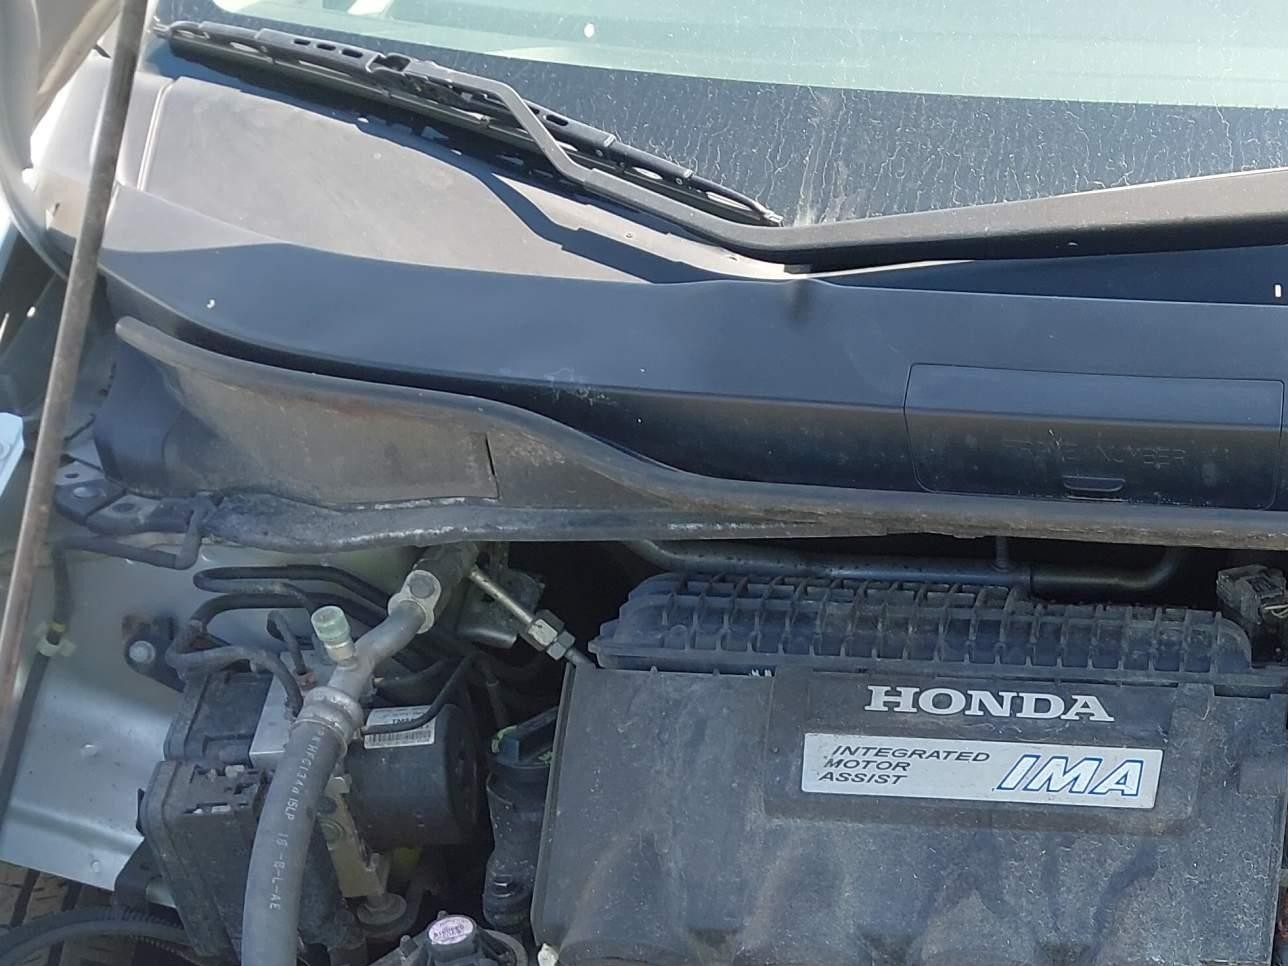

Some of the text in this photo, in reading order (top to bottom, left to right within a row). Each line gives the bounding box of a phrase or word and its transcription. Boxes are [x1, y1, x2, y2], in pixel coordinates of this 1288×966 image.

[864, 685, 1115, 722] HONDA
[832, 744, 990, 762] INTEGRATED
[824, 758, 911, 772] MOTOR
[818, 771, 908, 785] ASSIST
[995, 754, 1143, 796] IMA
